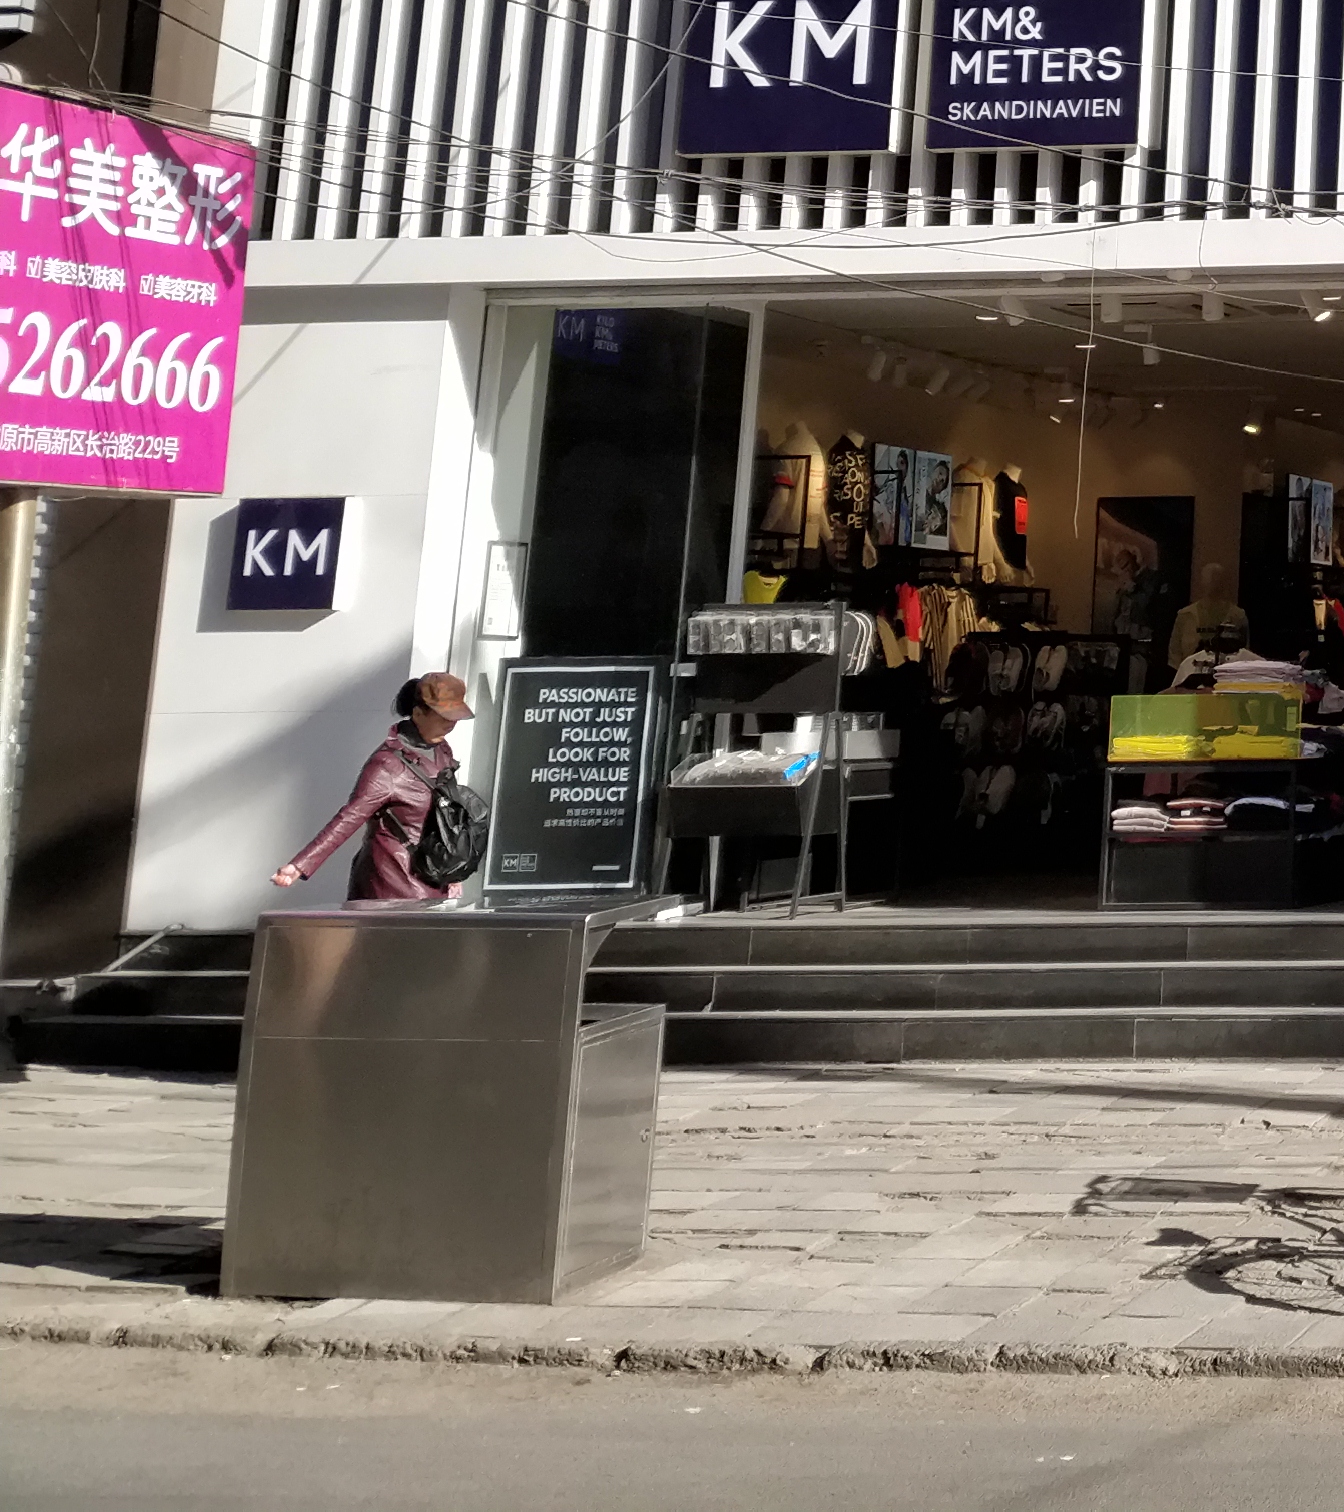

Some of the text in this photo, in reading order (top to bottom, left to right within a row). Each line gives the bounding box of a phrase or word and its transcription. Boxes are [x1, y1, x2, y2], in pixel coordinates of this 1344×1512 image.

[951, 5, 1044, 43] KM&
[949, 45, 1124, 86] METERS
[947, 97, 1122, 122] SKANDINAVIEN
[0, 122, 243, 251] 华美整形
[42, 257, 126, 293] 美容皮肤科
[153, 275, 218, 307] 美容牙科
[242, 528, 330, 578] KM
[538, 687, 638, 703] PASSIONATE
[523, 707, 636, 723] BUT NOT JUST
[560, 727, 632, 745] FOLLOW,
[547, 747, 631, 763] LOOK FOR
[530, 767, 631, 783] HIGH-VALUE
[548, 787, 628, 803] PRODUCT
